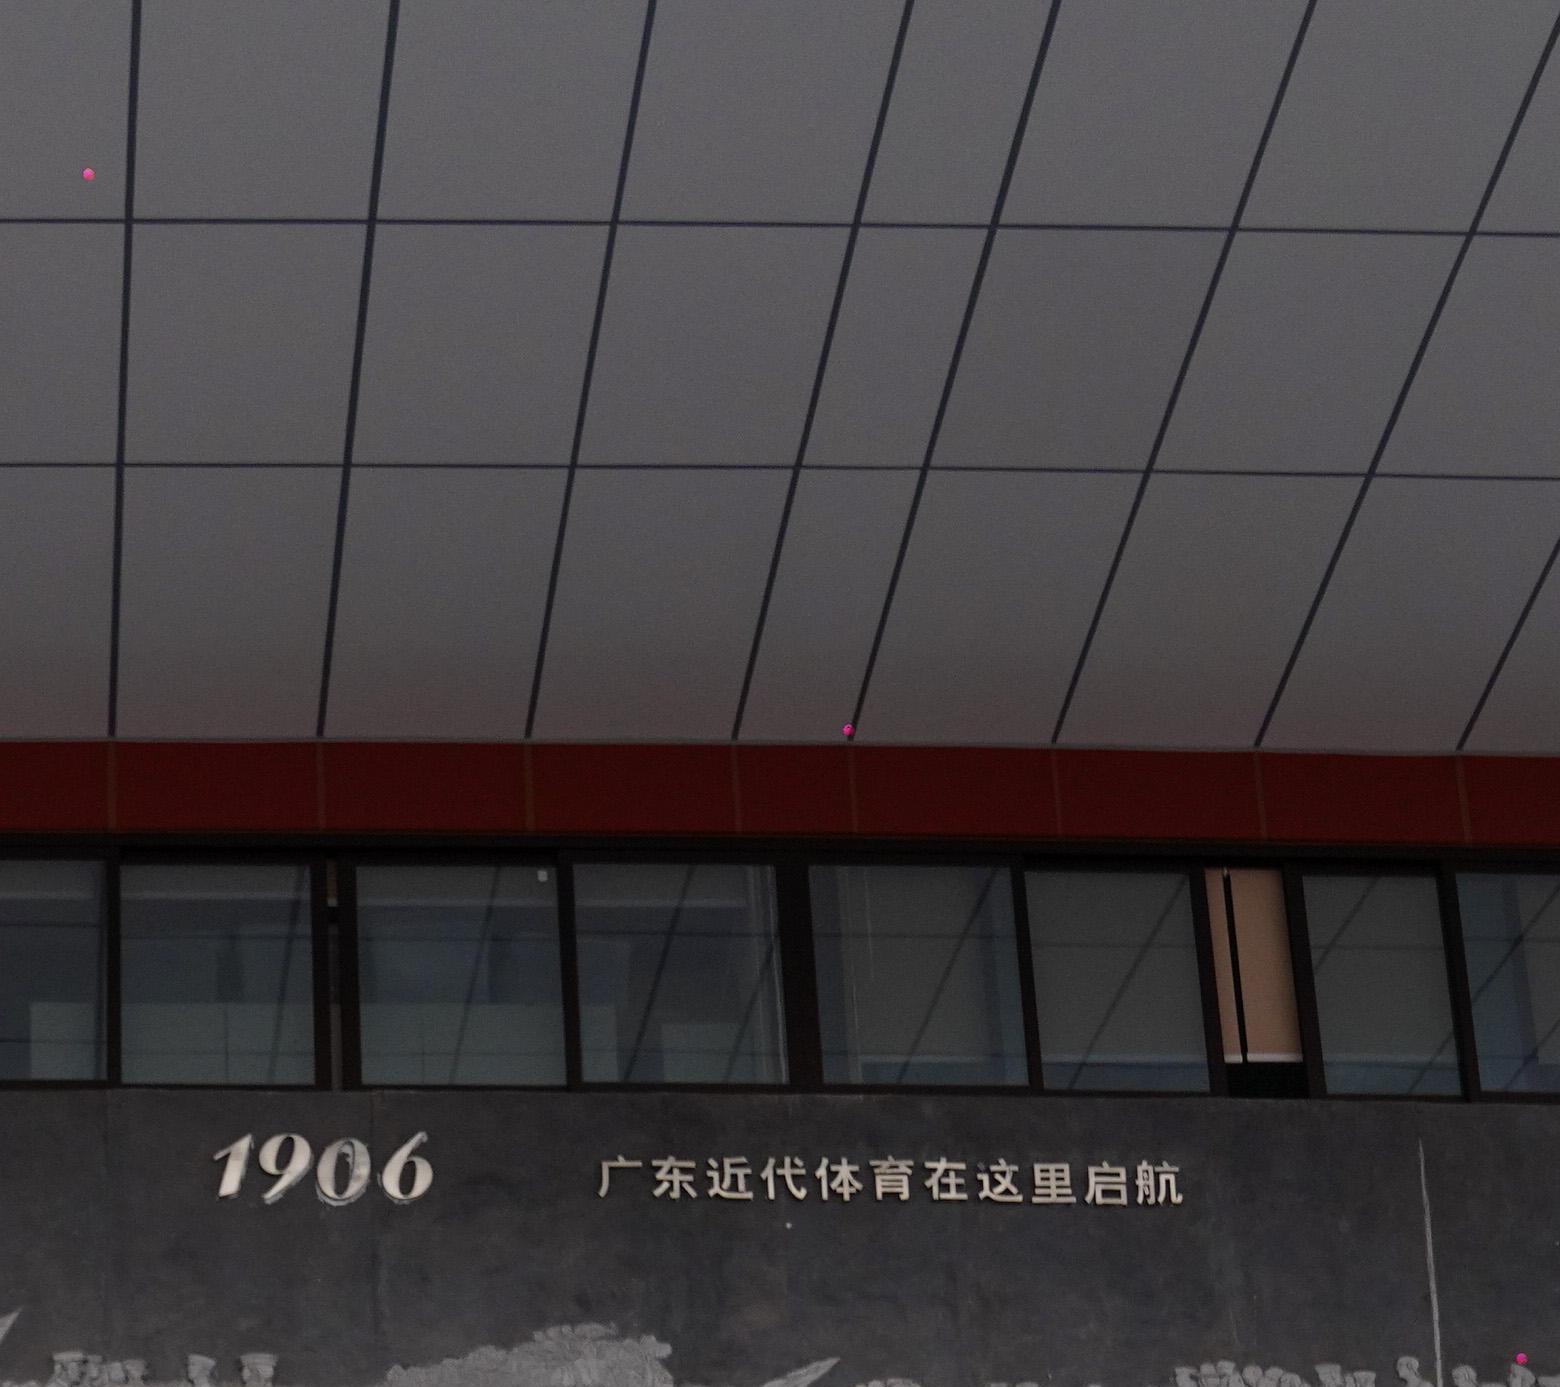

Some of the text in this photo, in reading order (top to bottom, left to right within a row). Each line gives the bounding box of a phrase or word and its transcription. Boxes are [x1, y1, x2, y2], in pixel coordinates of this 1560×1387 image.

[213, 1132, 433, 1207] 1906
[598, 1155, 1184, 1207] 广东近代体育在这里启航
